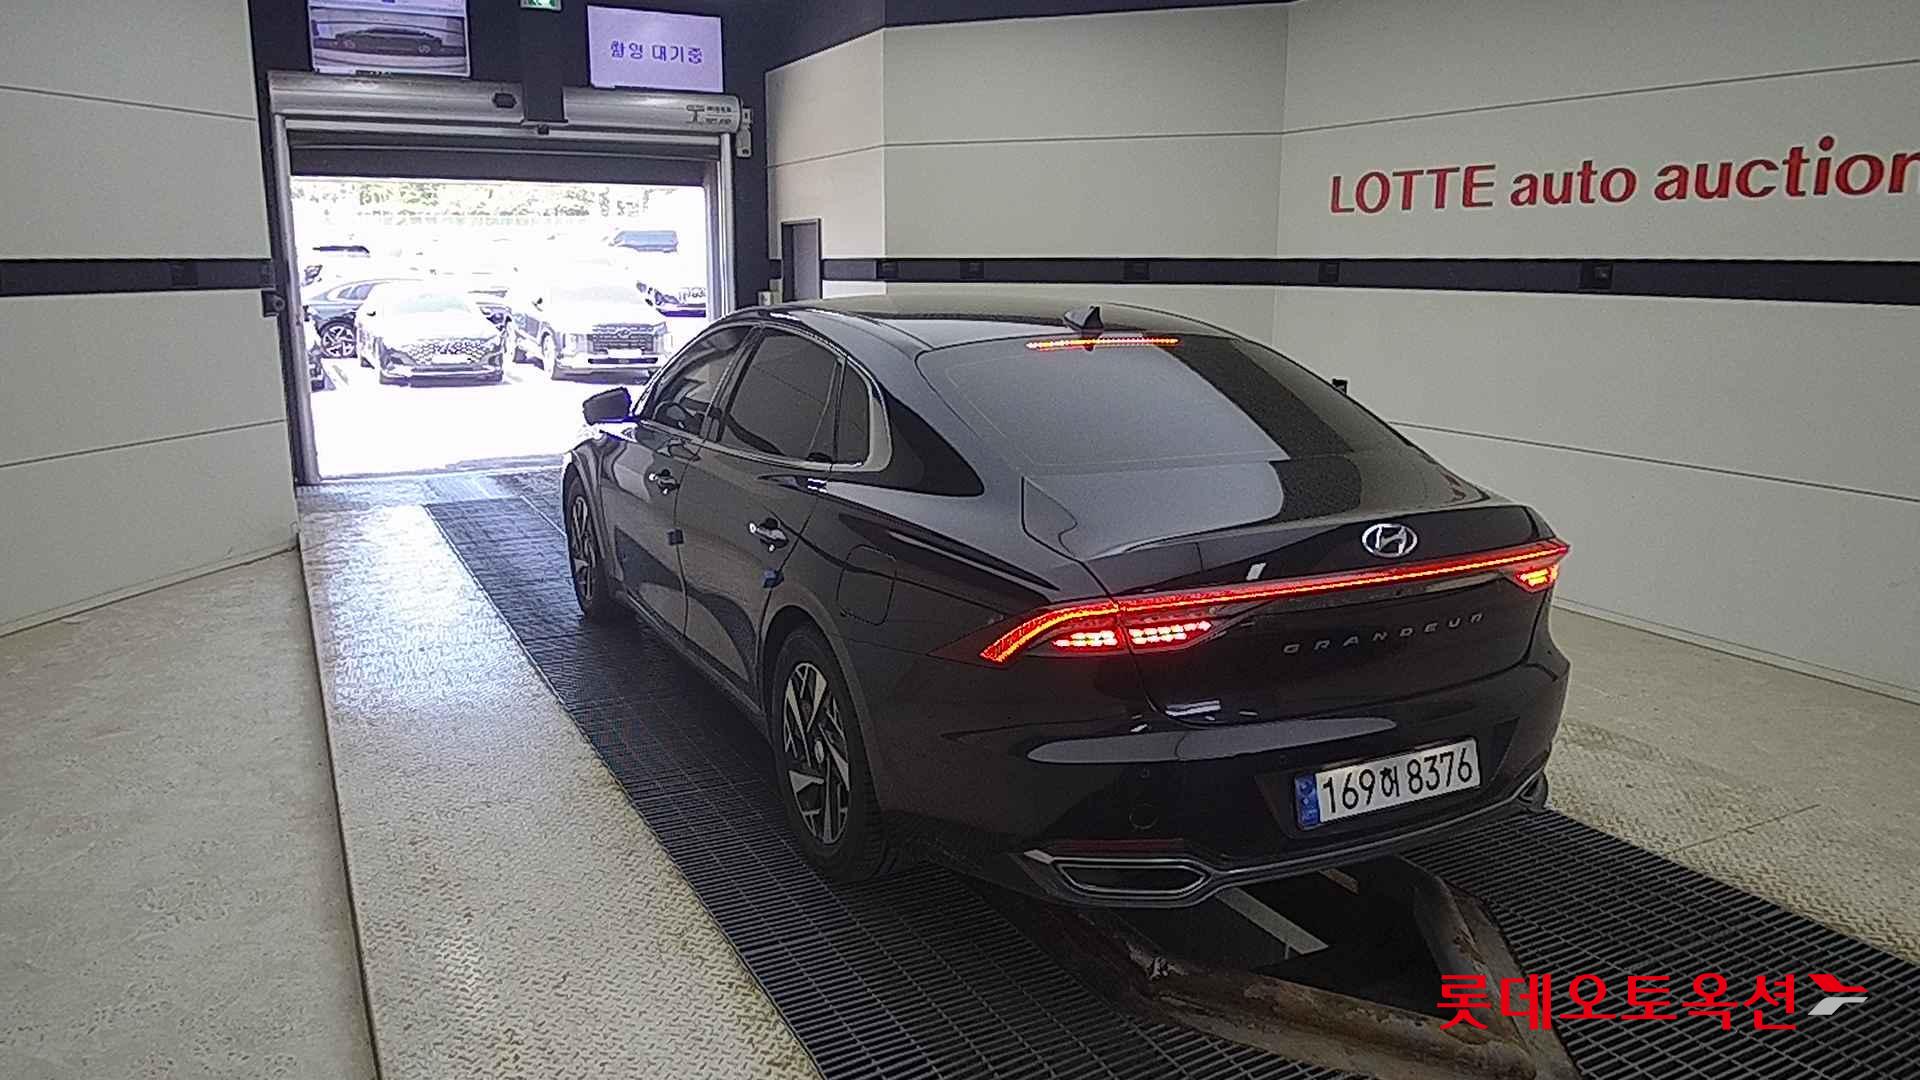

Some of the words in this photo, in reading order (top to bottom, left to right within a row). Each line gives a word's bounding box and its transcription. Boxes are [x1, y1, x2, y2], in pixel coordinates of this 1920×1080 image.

[652, 44, 702, 65] 대기중
[1330, 163, 1496, 214] LOTTE
[1510, 160, 1637, 206] auto
[1283, 612, 1484, 655] GRANDEUR
